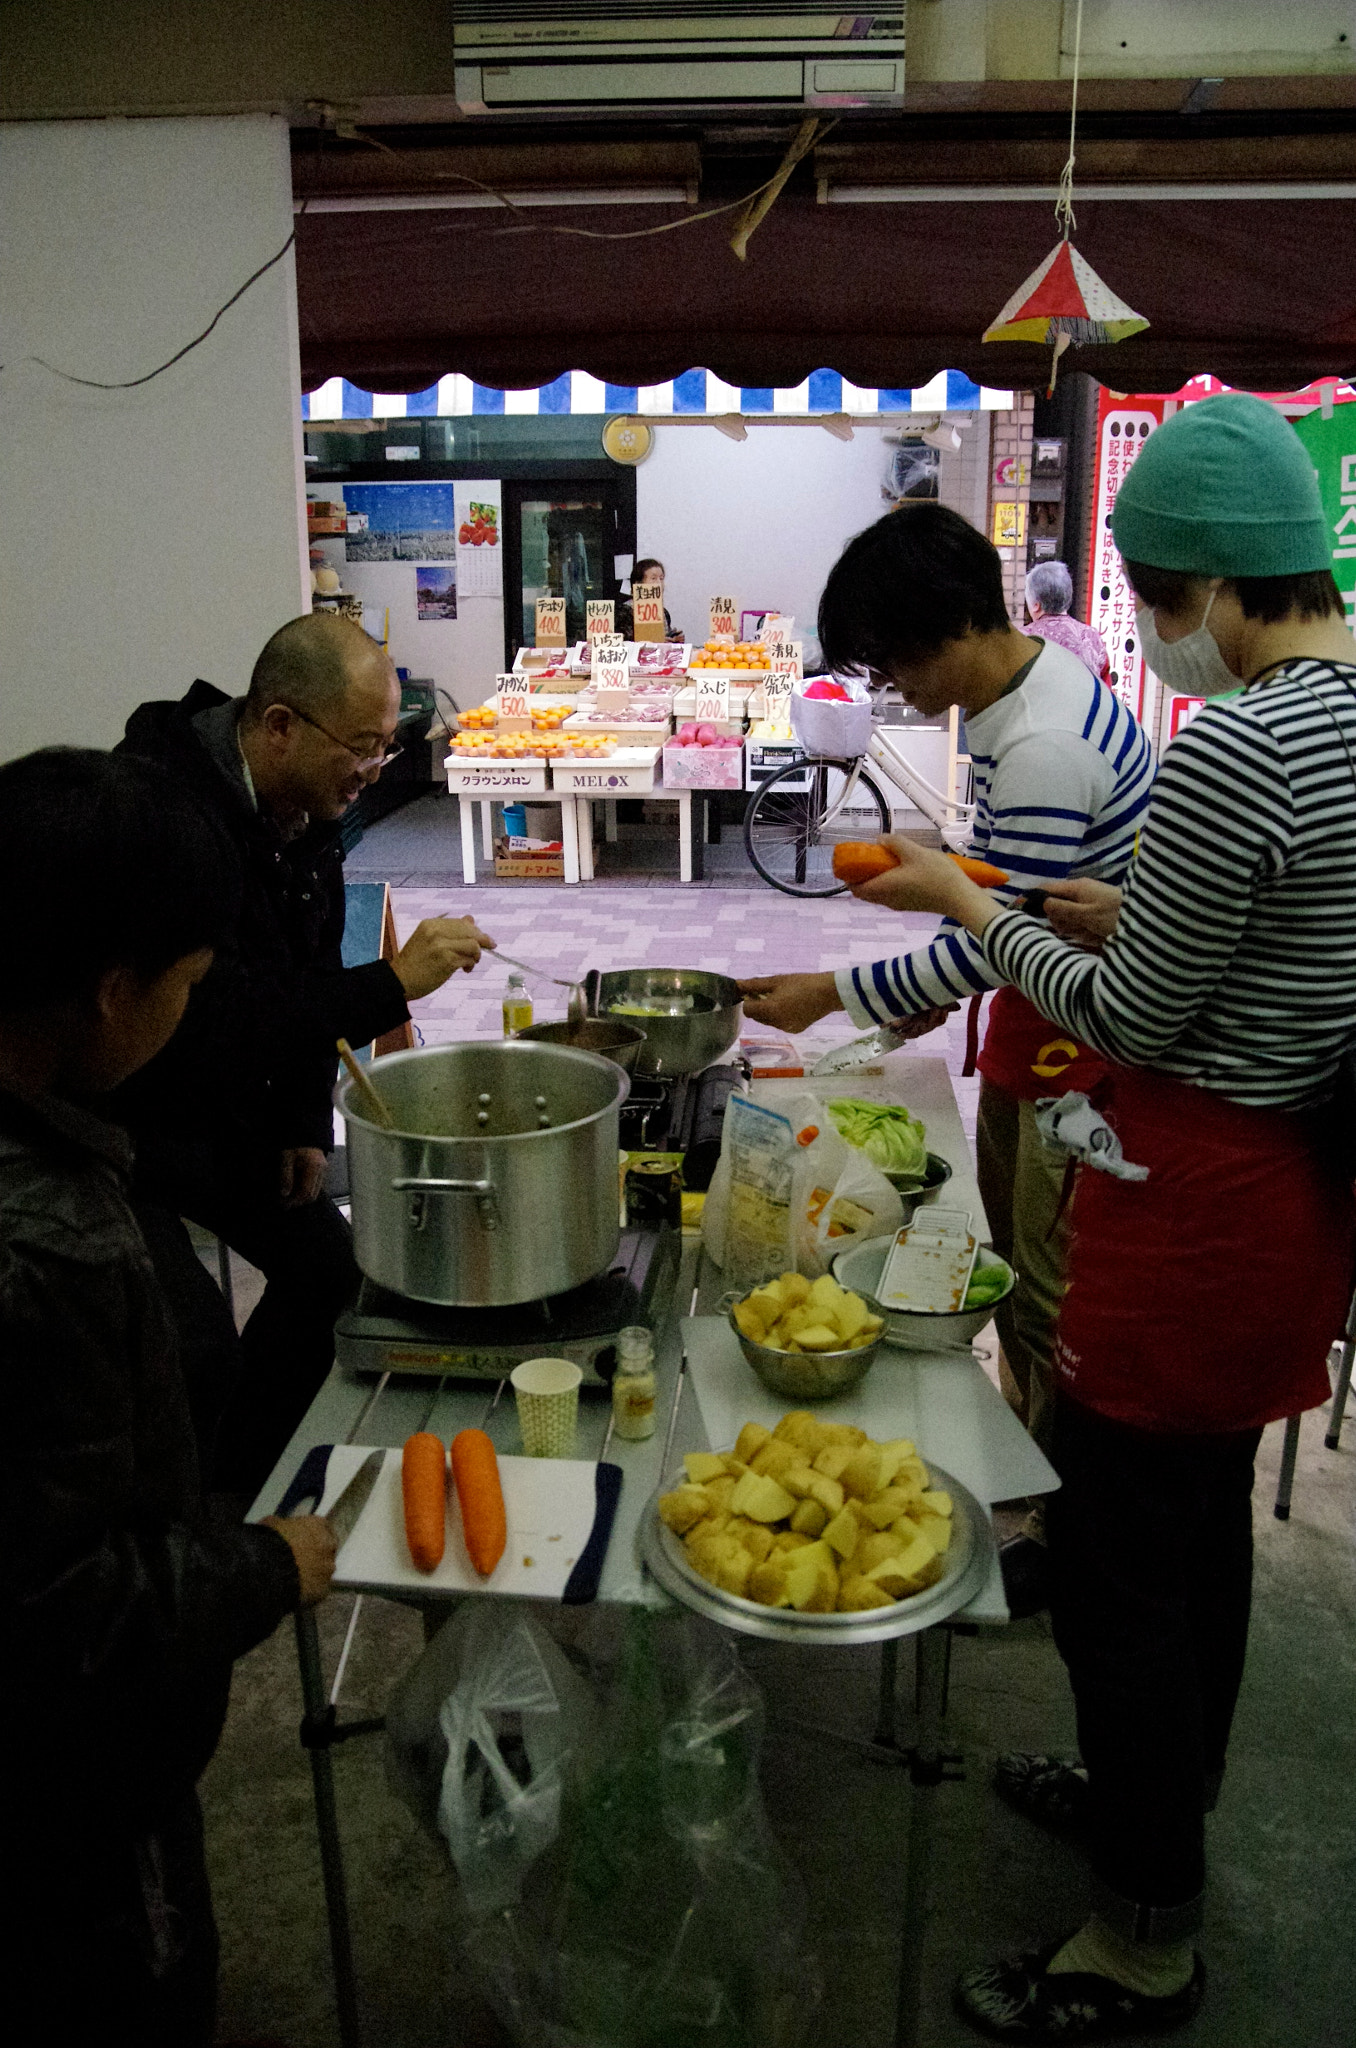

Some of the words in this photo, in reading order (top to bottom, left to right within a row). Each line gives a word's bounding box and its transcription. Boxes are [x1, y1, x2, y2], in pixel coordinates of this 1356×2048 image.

[1122, 440, 1134, 482] 使わ
[1105, 440, 1120, 512] 記念切手
[1101, 533, 1114, 583] はがき
[710, 597, 735, 614] 清見
[1098, 604, 1110, 648] テレ
[597, 649, 628, 664] あまおう
[771, 643, 798, 658] 清見
[497, 677, 528, 692] みかん
[699, 681, 727, 695] ふじ
[1122, 656, 1134, 706] 切れた
[461, 775, 532, 786] クラウンメロン
[572, 775, 629, 787] MELOX
[524, 865, 559, 874] トマト
